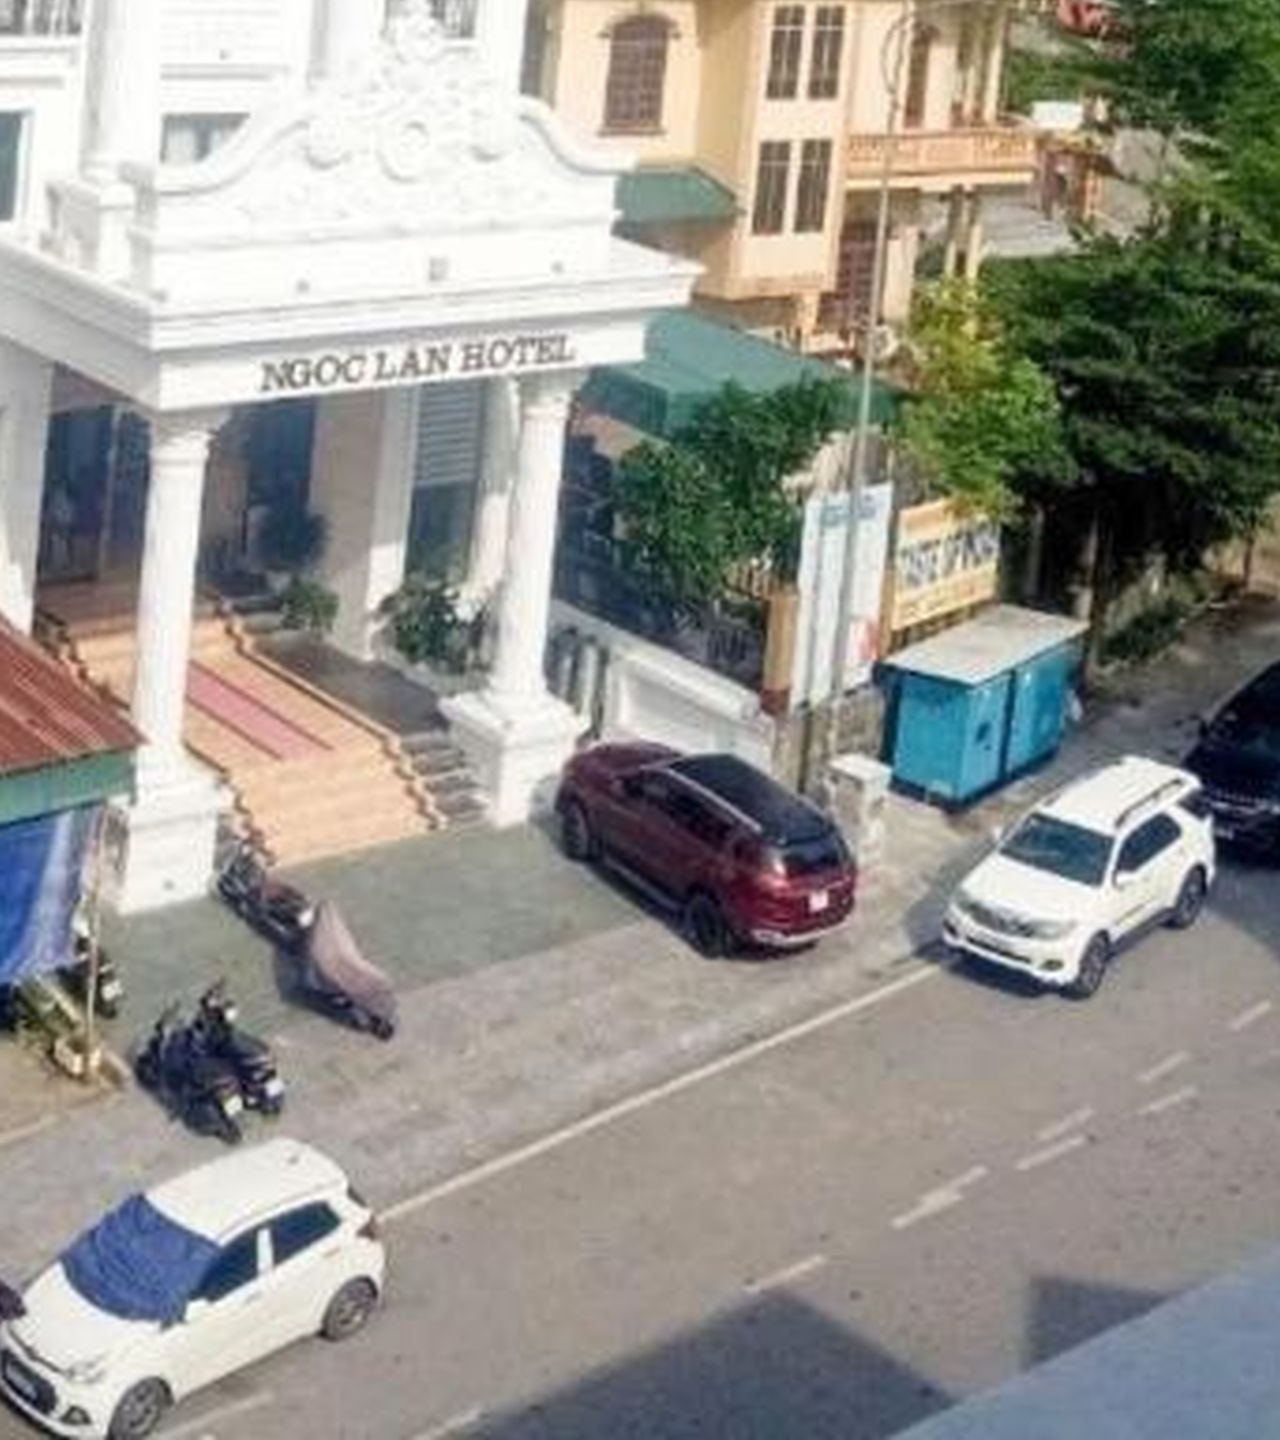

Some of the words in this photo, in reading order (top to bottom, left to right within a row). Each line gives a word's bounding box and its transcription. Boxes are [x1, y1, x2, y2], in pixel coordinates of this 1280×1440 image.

[261, 354, 367, 392] NGOC
[372, 344, 452, 382] LAN
[458, 334, 576, 372] HOTEL
